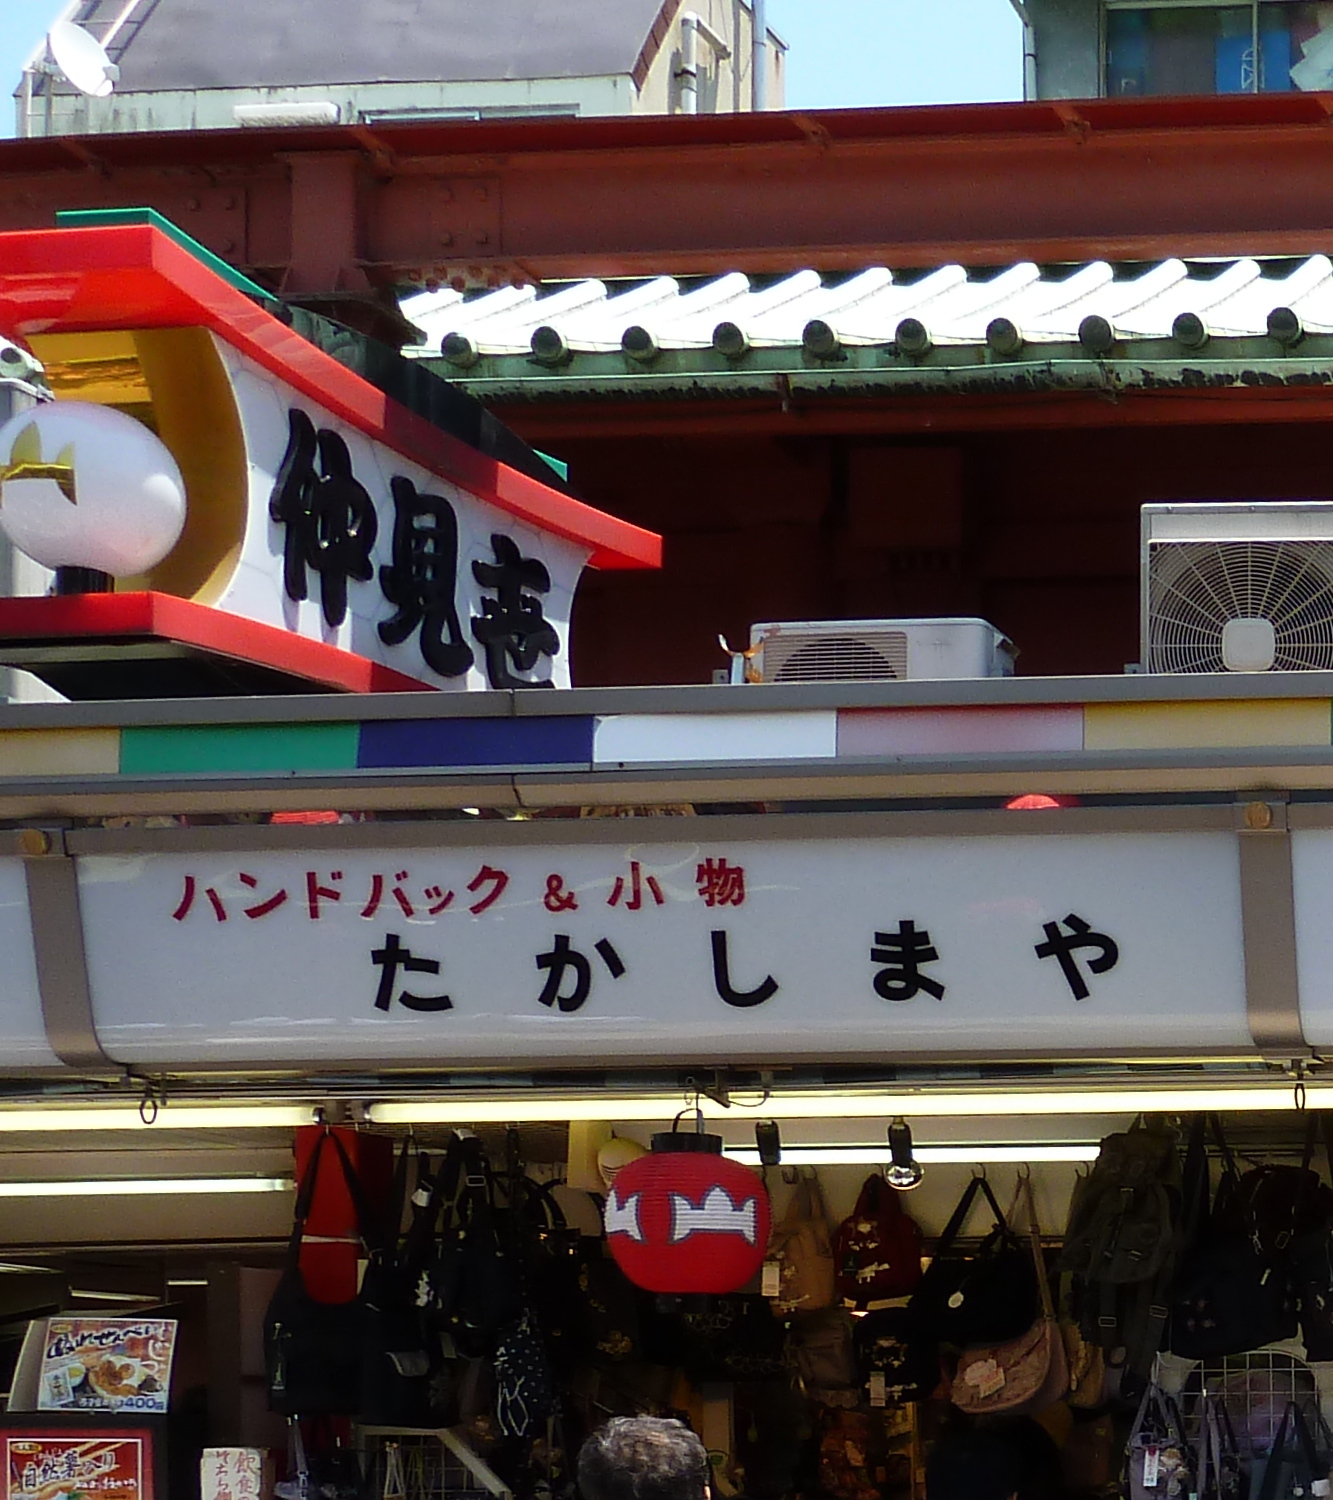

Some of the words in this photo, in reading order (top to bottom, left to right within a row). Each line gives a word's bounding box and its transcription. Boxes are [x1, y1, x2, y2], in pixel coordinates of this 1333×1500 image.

[173, 865, 510, 922] ハンドバック
[544, 874, 579, 912] &
[607, 858, 746, 911] 小物
[370, 912, 1121, 1013] たかしまや
